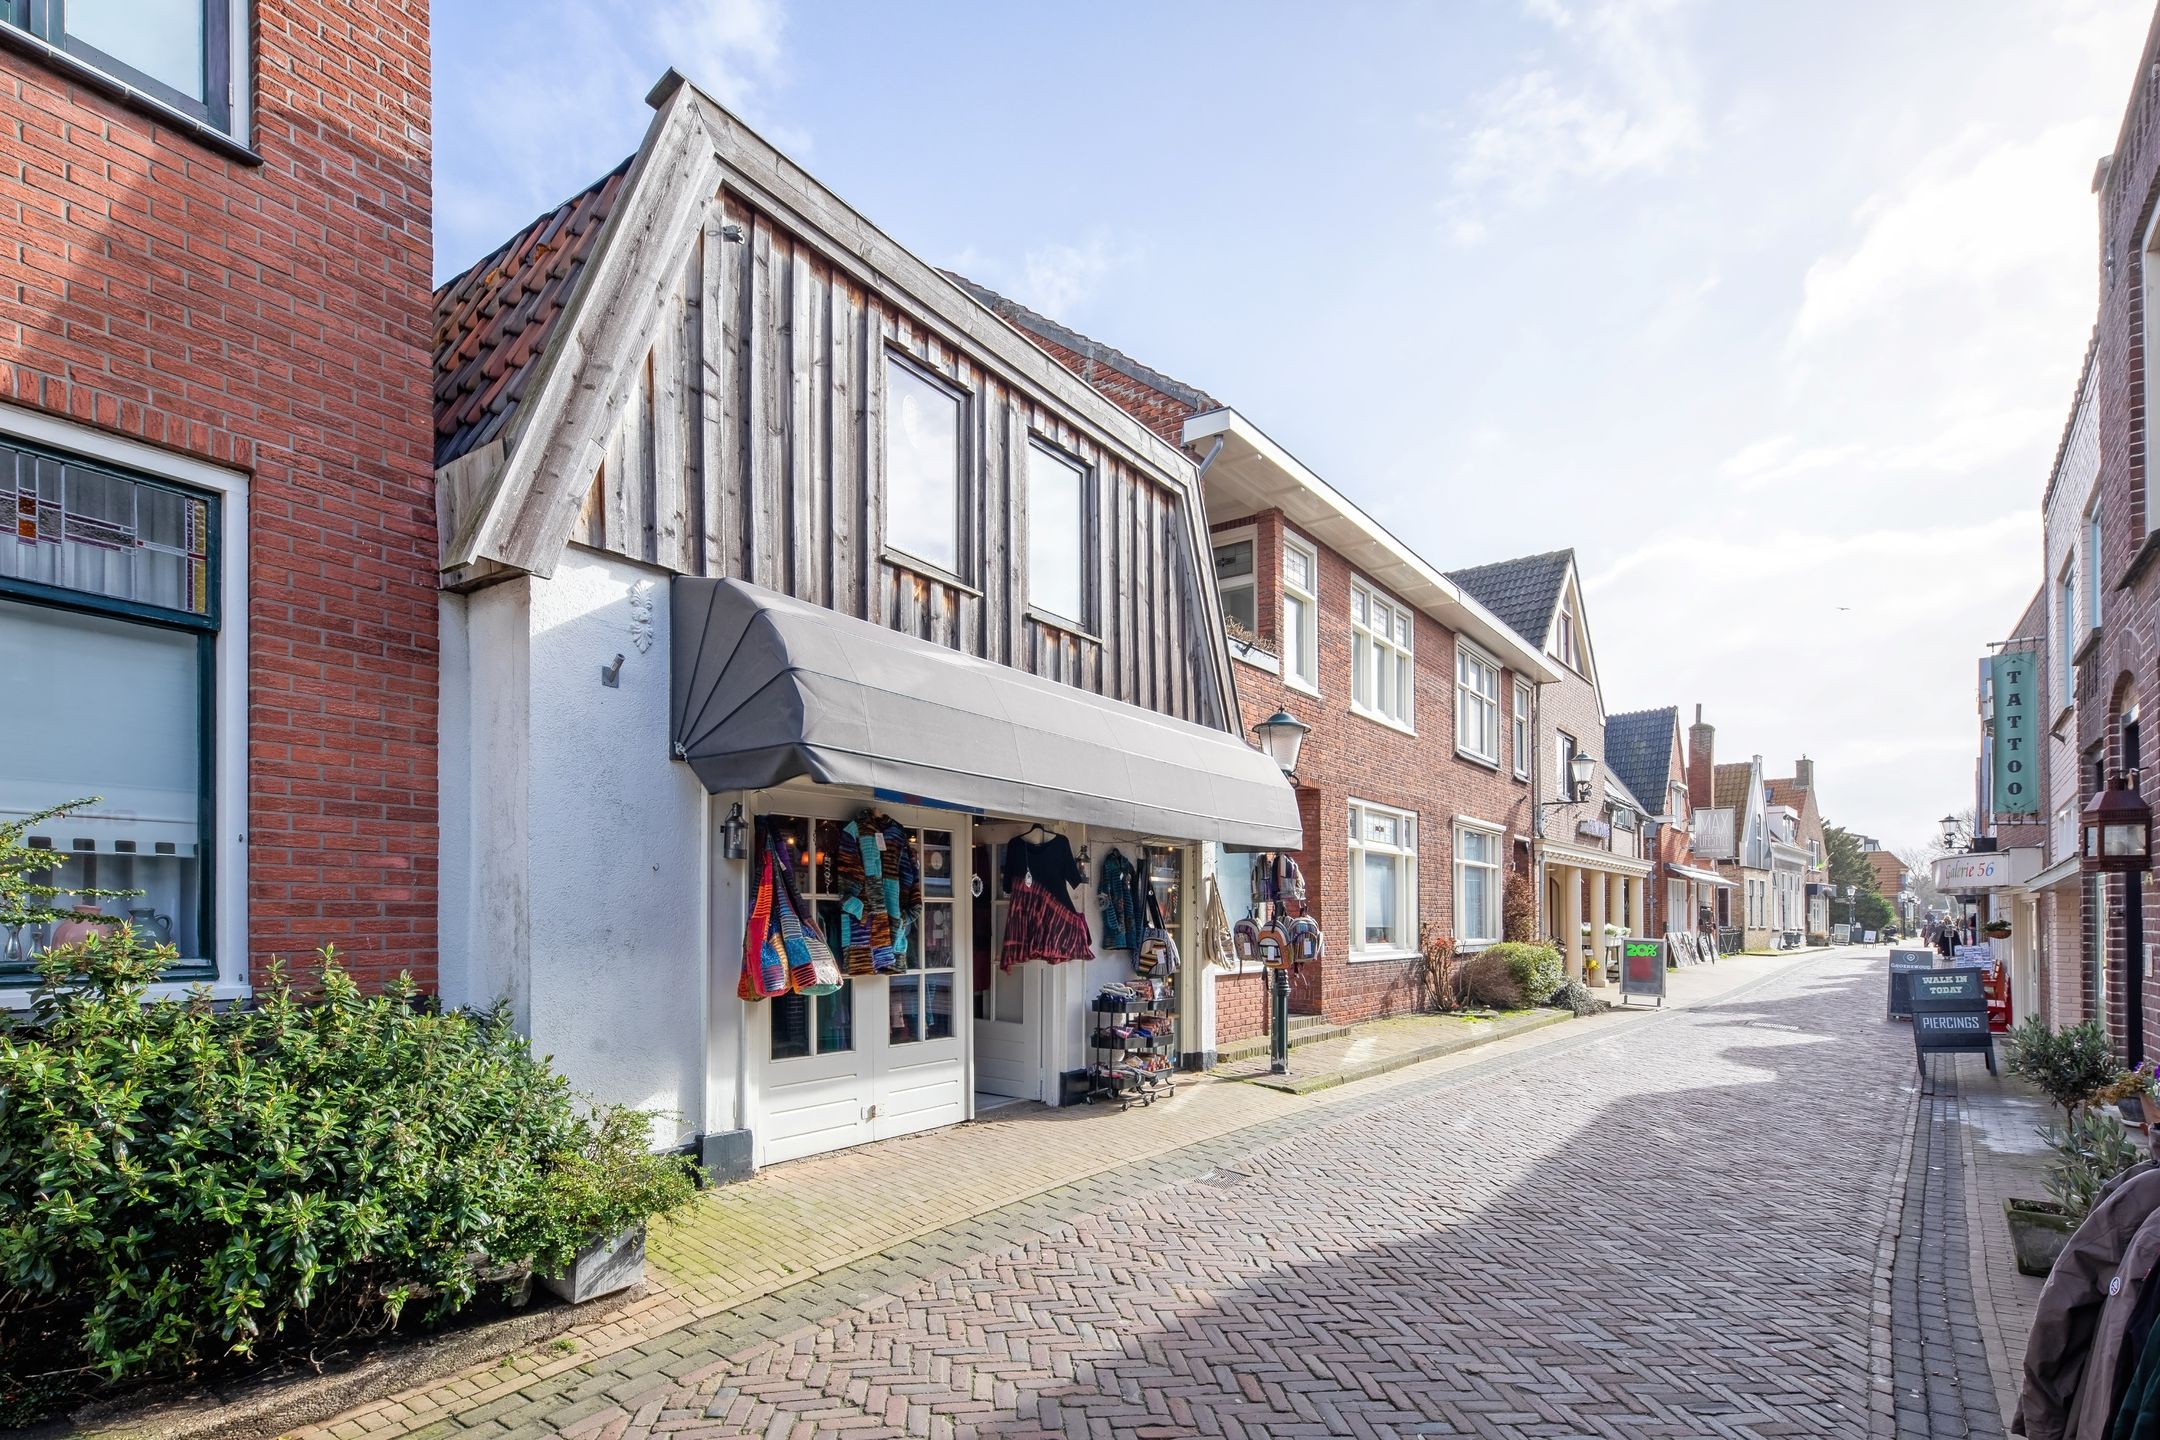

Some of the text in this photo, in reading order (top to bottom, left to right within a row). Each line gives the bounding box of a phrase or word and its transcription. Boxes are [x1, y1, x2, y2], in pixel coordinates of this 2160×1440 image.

[2006, 671, 2022, 795] TATTOO
[1699, 813, 1729, 834] MAX
[1945, 860, 1994, 887] Galerie 56
[1626, 944, 1658, 957] 20%
[1922, 975, 1968, 984] WALK IN
[1929, 986, 1963, 994] TODAY
[1922, 1016, 1980, 1029] PIERCINGS
